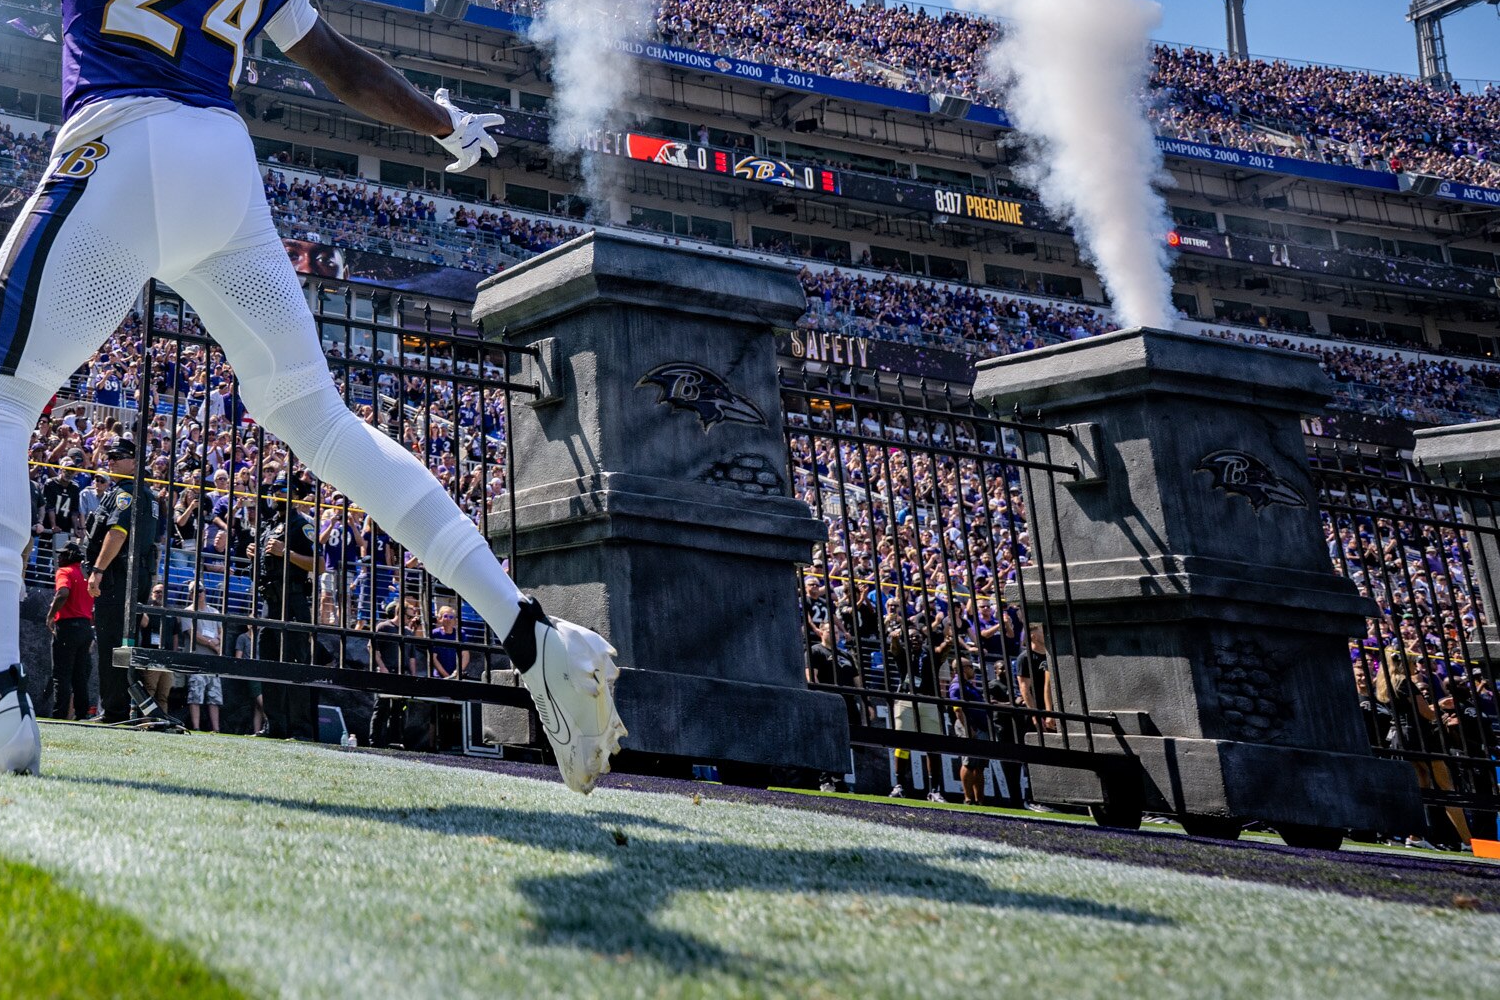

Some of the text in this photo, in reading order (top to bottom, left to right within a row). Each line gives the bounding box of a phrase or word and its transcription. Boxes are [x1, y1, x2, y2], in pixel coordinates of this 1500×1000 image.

[602, 37, 644, 55] WORLD
[646, 46, 711, 68] CHAMPIONS
[735, 63, 763, 79] 2000
[787, 73, 815, 89] 2012
[53, 140, 110, 179] B
[697, 147, 707, 170] 0
[1156, 140, 1275, 169] HAMPIONS 2000 2012
[804, 166, 814, 190] 0
[934, 189, 1024, 226] 8:07 PREGAME
[1463, 188, 1500, 204] AFC NO
[1180, 236, 1209, 248] LOTTERY
[791, 329, 869, 369] SAFETY
[103, 379, 119, 392] 89
[56, 495, 72, 518] 14
